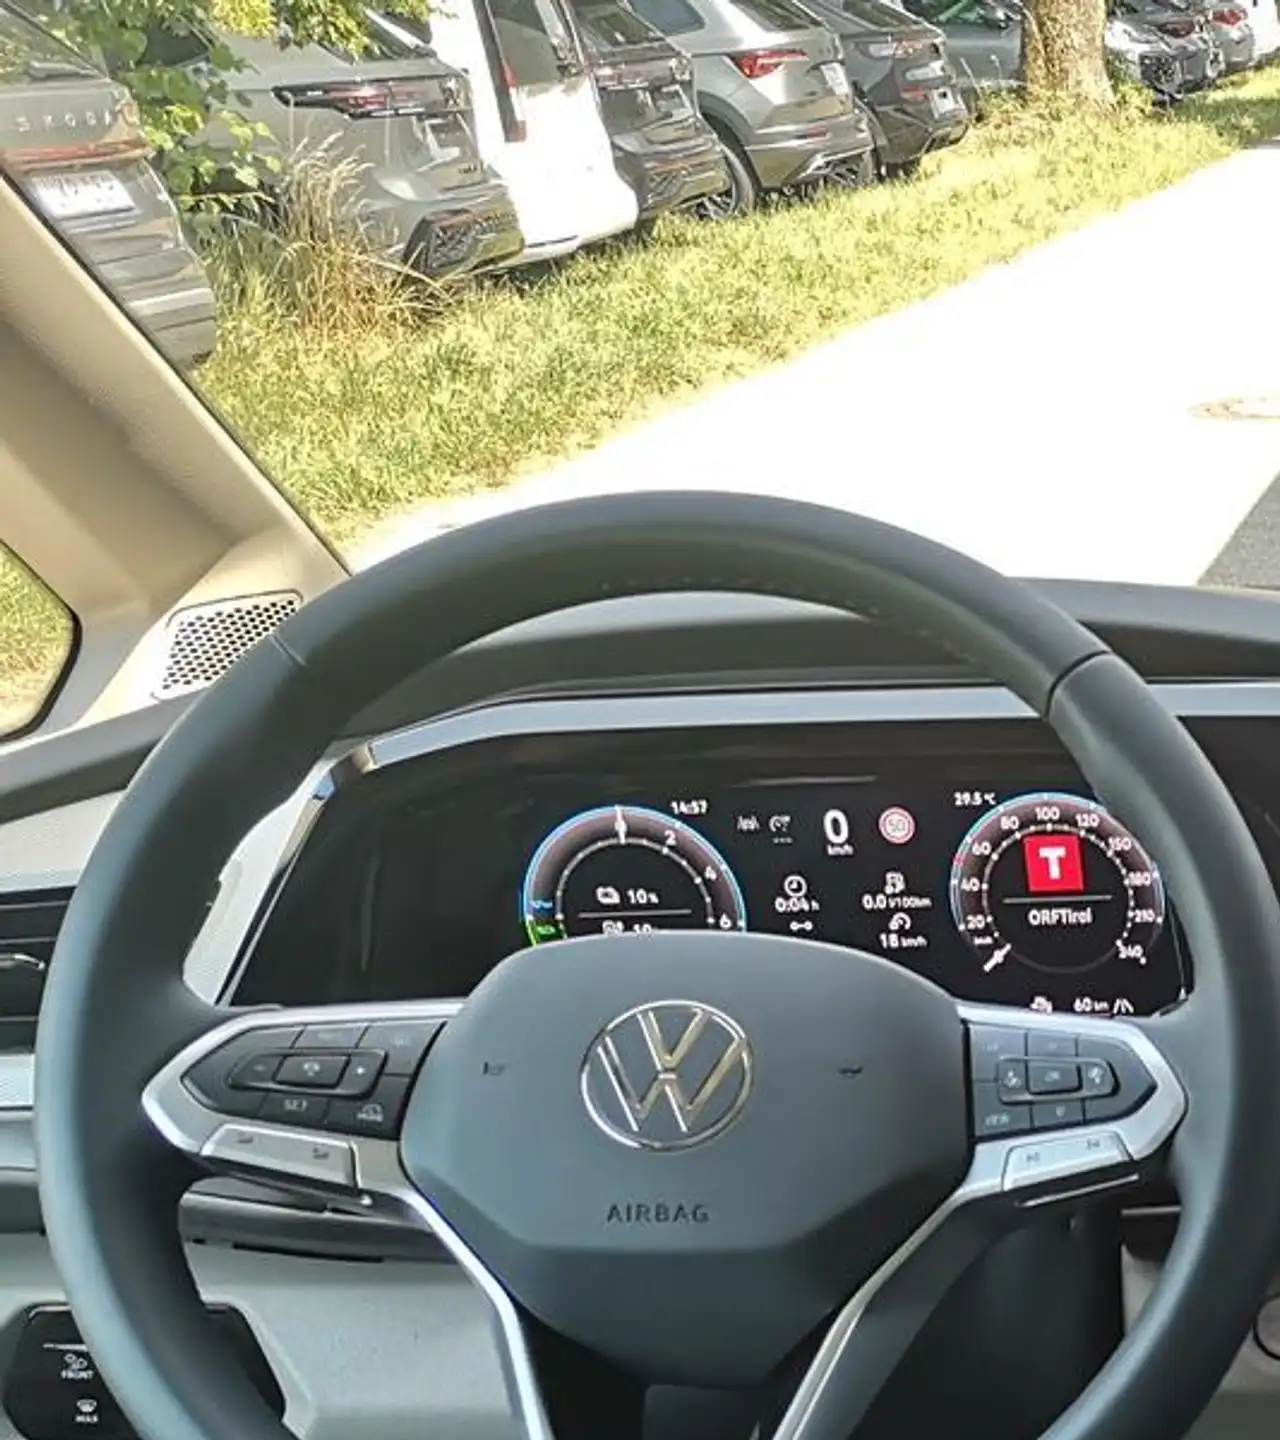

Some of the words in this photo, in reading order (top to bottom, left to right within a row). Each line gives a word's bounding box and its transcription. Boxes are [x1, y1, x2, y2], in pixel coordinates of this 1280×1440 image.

[669, 800, 708, 815] 14:57
[1035, 806, 1060, 820] 100
[823, 808, 849, 844] 0
[1000, 815, 1019, 830] 80
[1075, 812, 1101, 828] 120
[663, 830, 677, 846] 2
[1107, 836, 1132, 853] 150
[971, 841, 991, 857] 60
[1038, 846, 1066, 880] T
[703, 865, 717, 881] 4
[960, 877, 980, 892] 40
[626, 888, 647, 905] 10
[775, 897, 809, 912] 0:04
[719, 913, 732, 929] 6
[966, 914, 986, 930] 20
[1073, 997, 1093, 1012] 60
[606, 1203, 710, 1224] AIRBAG
